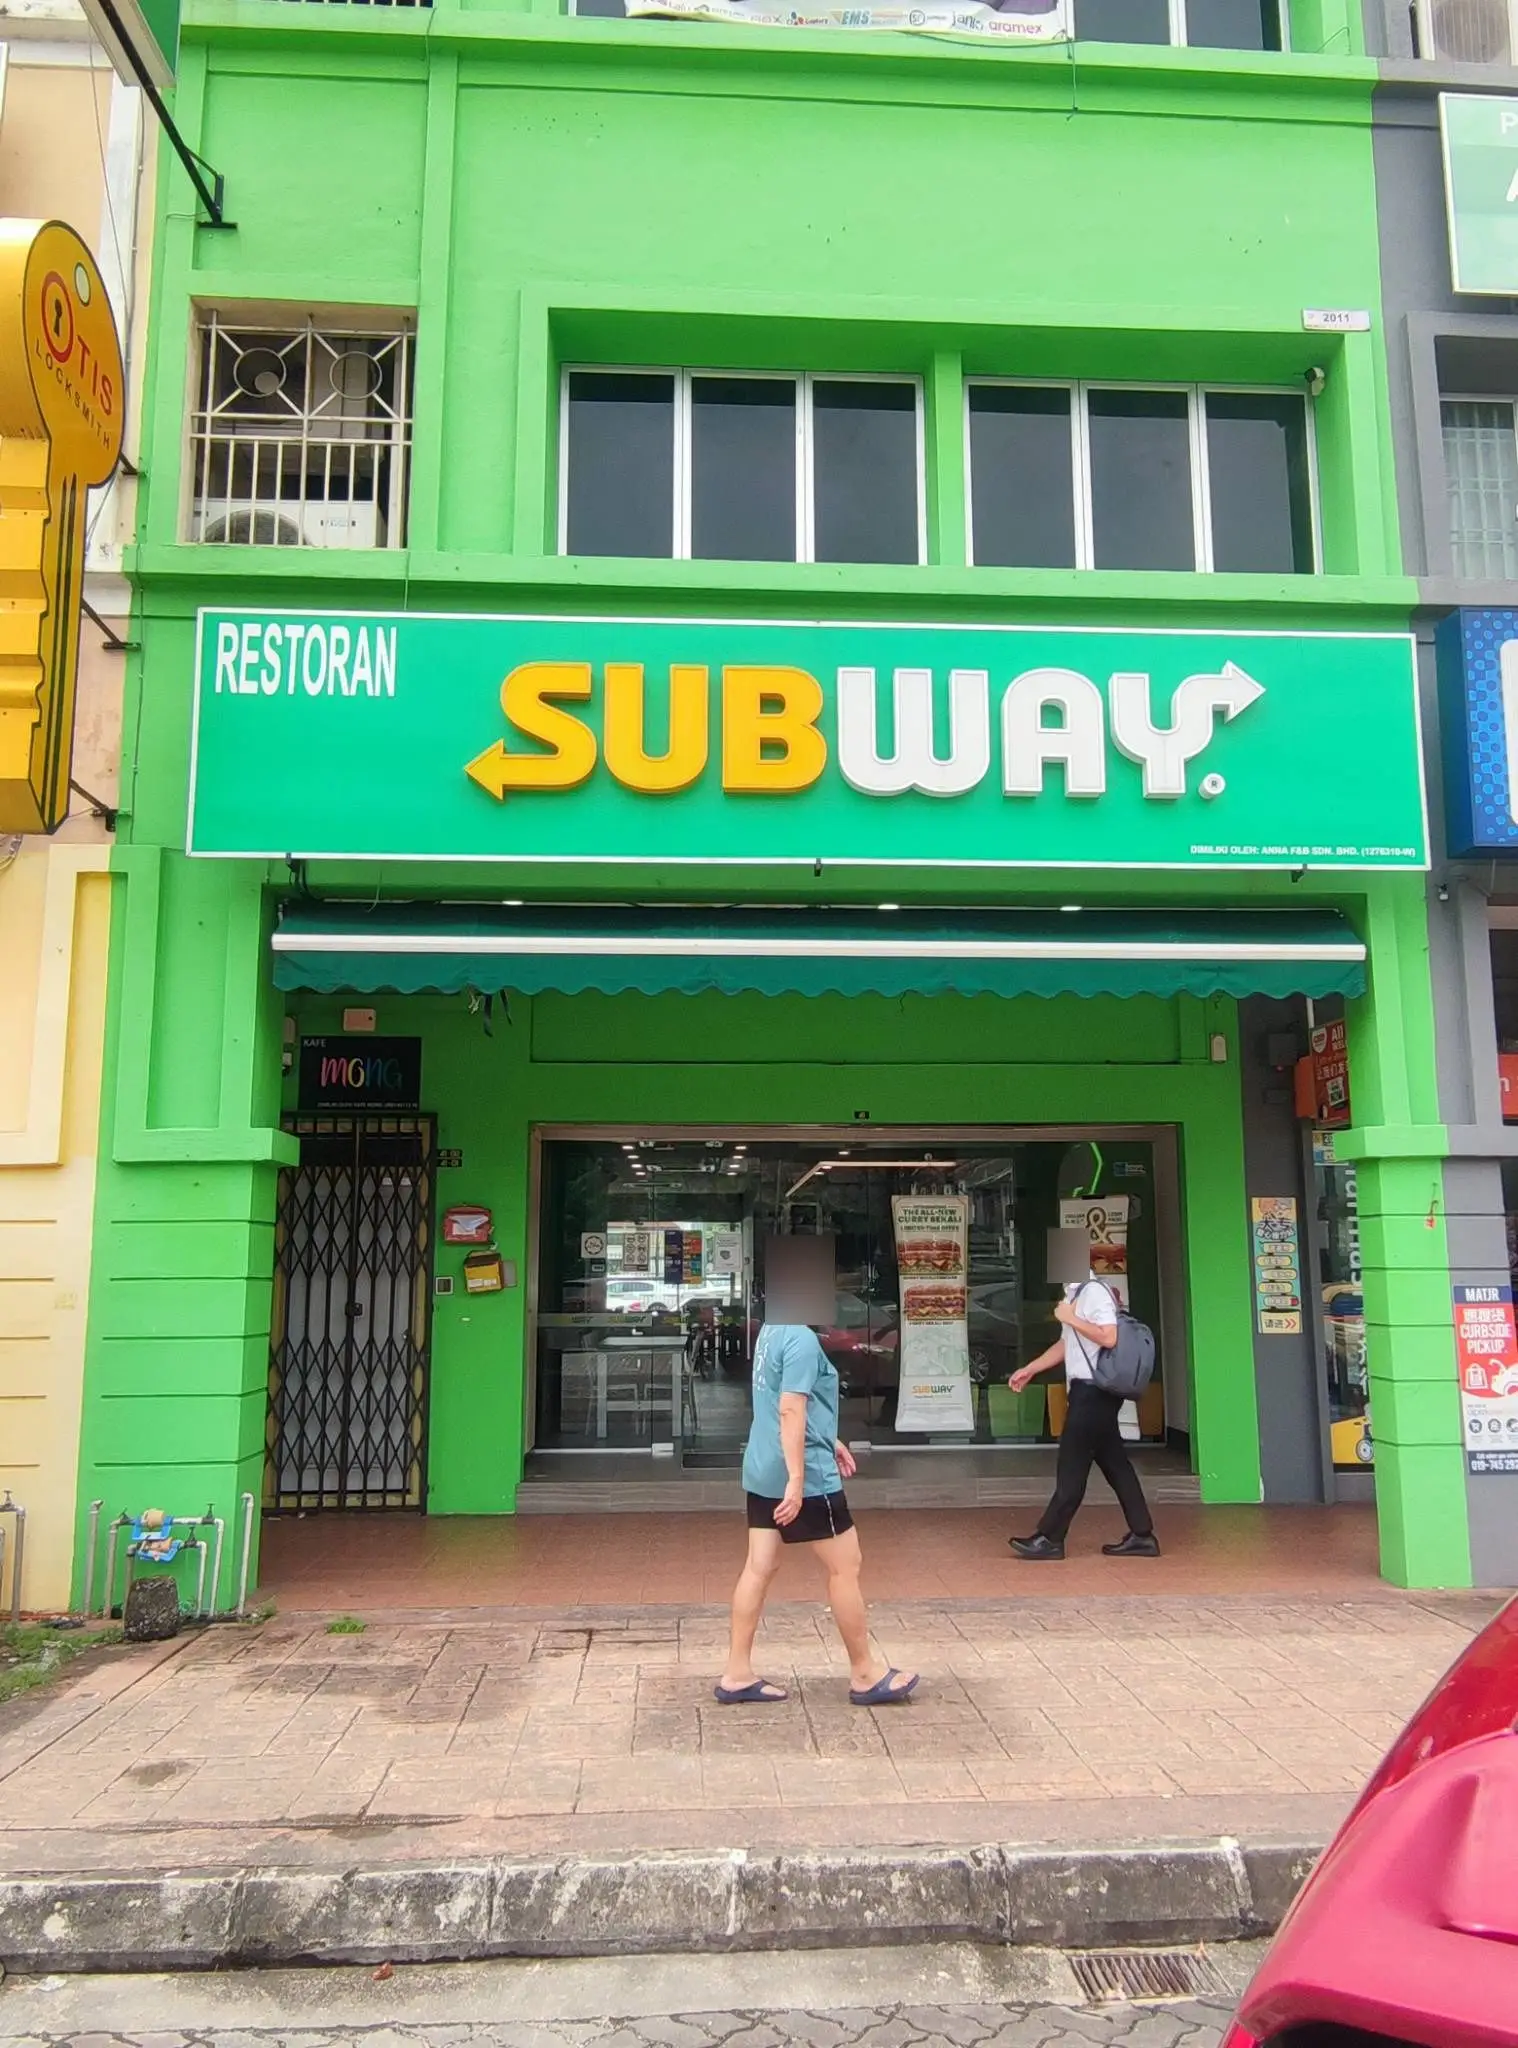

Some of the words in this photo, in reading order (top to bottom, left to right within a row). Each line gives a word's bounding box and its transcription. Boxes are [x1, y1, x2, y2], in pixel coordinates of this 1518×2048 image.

[988, 20, 1043, 35] aramex
[1323, 313, 1350, 323] 2011
[35, 338, 110, 450] LOCKSMITH
[214, 621, 398, 698] RESTORAN
[464, 659, 1266, 804] SUBWAY
[303, 1038, 327, 1048] KAFE
[1459, 1323, 1512, 1339] CURBSIDE
[911, 1384, 956, 1394] SUBWAY
